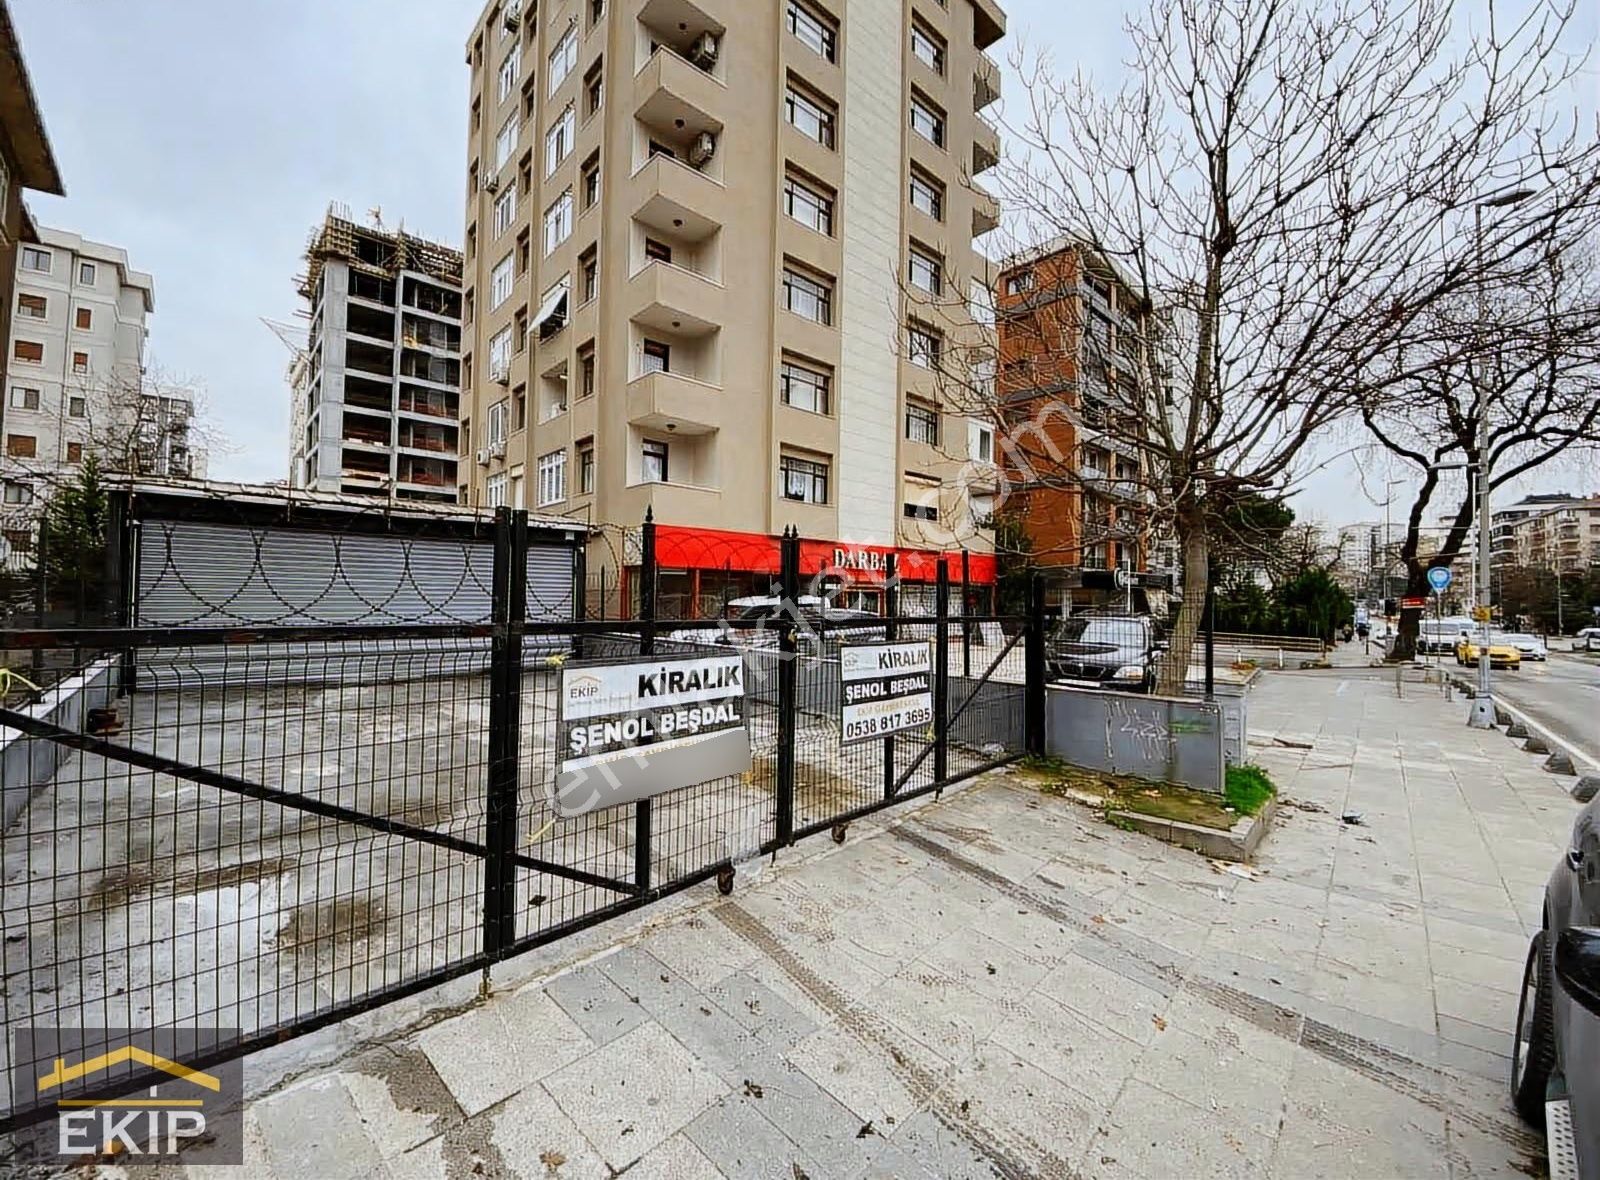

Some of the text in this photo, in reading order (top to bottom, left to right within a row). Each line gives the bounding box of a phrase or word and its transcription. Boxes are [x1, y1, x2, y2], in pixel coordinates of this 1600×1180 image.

[878, 647, 928, 670] KİRALIK
[570, 682, 598, 699] EKİP
[638, 665, 741, 698] KİRALIK
[846, 675, 928, 704] ŞENOL BEŞDAL
[570, 717, 654, 756] ŞENOL
[661, 703, 741, 734] BEŞDAL
[846, 707, 931, 738] 0538 817 3695
